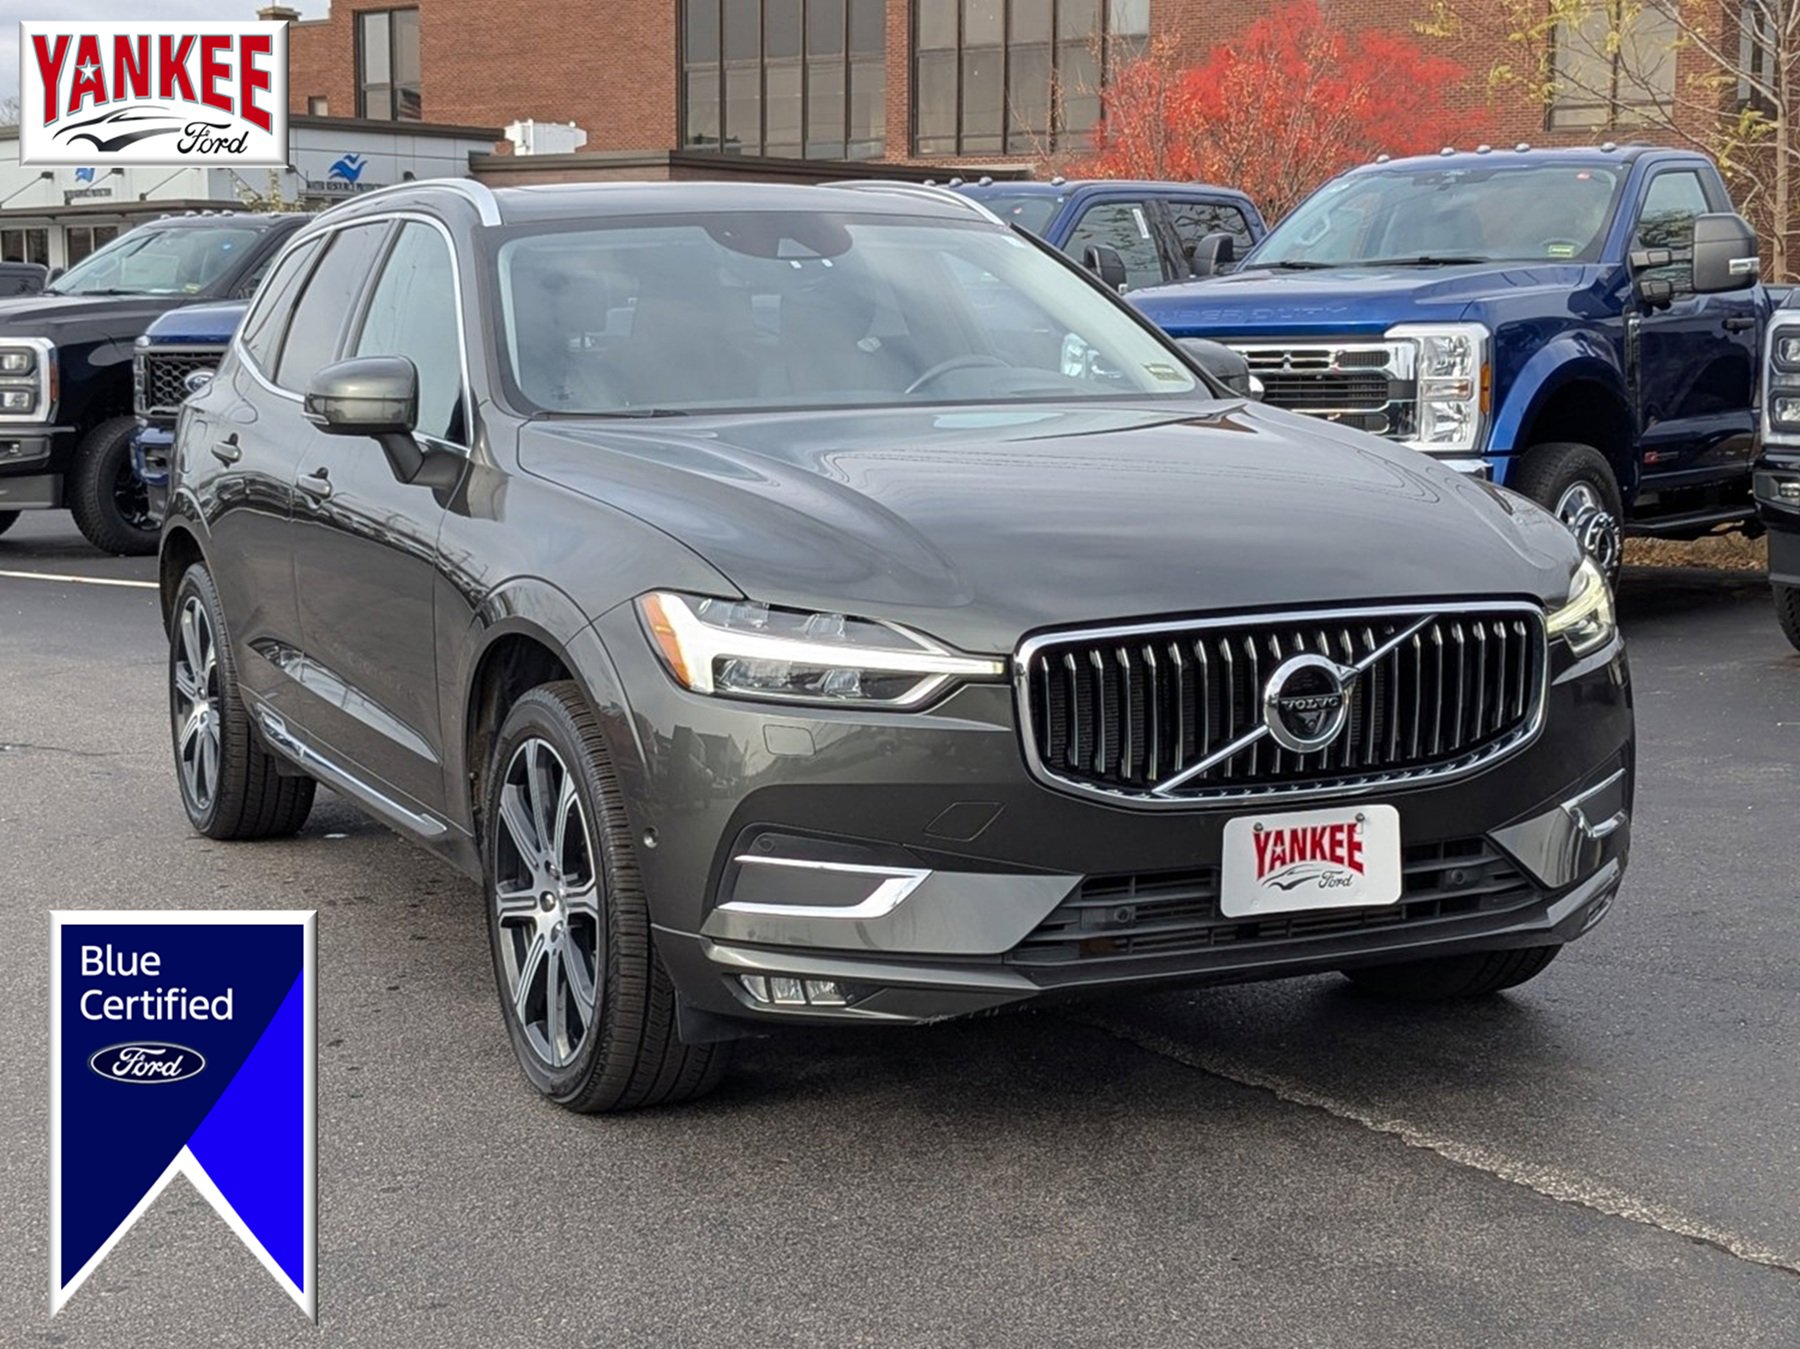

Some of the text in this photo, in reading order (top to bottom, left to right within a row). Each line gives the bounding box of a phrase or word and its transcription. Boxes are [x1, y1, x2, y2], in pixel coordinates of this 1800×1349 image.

[1280, 697, 1338, 710] VOLVO
[1253, 822, 1365, 881] YANKEE
[1318, 870, 1354, 889] Ford
